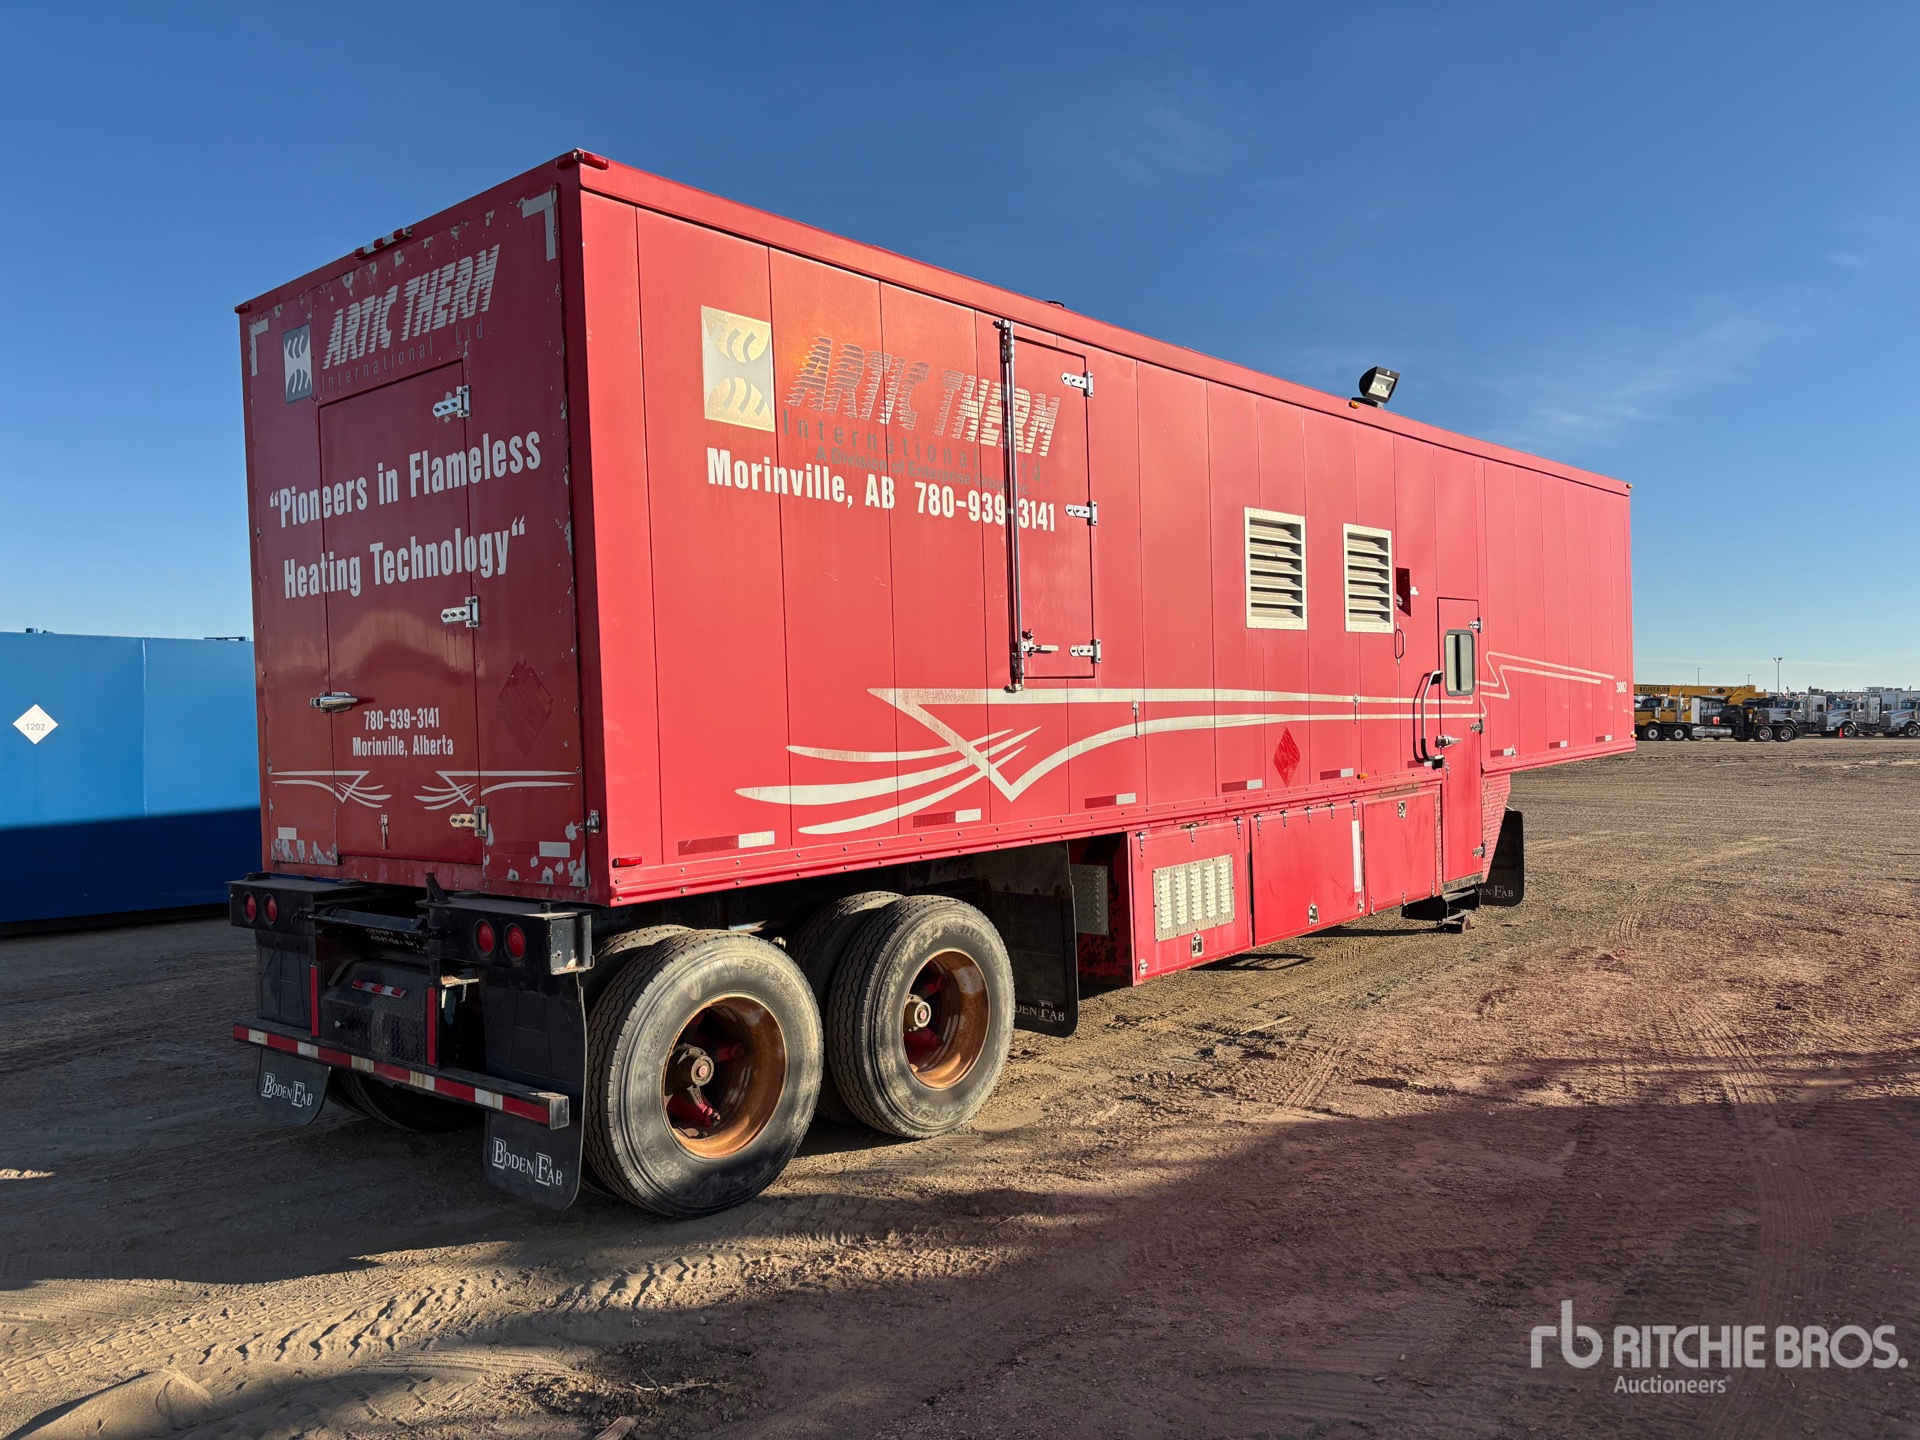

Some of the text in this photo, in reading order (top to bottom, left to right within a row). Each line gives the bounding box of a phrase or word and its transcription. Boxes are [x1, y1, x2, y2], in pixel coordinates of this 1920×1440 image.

[321, 243, 500, 369] ARTIC THERM
[321, 335, 433, 393] International
[784, 337, 1061, 457] ARTIC THERM
[377, 461, 399, 505] in
[409, 430, 541, 498] Flameless
[783, 410, 978, 469] International
[816, 445, 827, 462] A
[831, 447, 888, 471] Division
[891, 459, 905, 475] of
[908, 461, 971, 485] Enterprise
[706, 447, 1055, 532] Morinville, AB 780-939-3141
[283, 551, 361, 600] Heating
[25, 722, 46, 731] 1202
[352, 734, 454, 758] Morinville, Alberta
[363, 706, 440, 731] 780-939-3141
